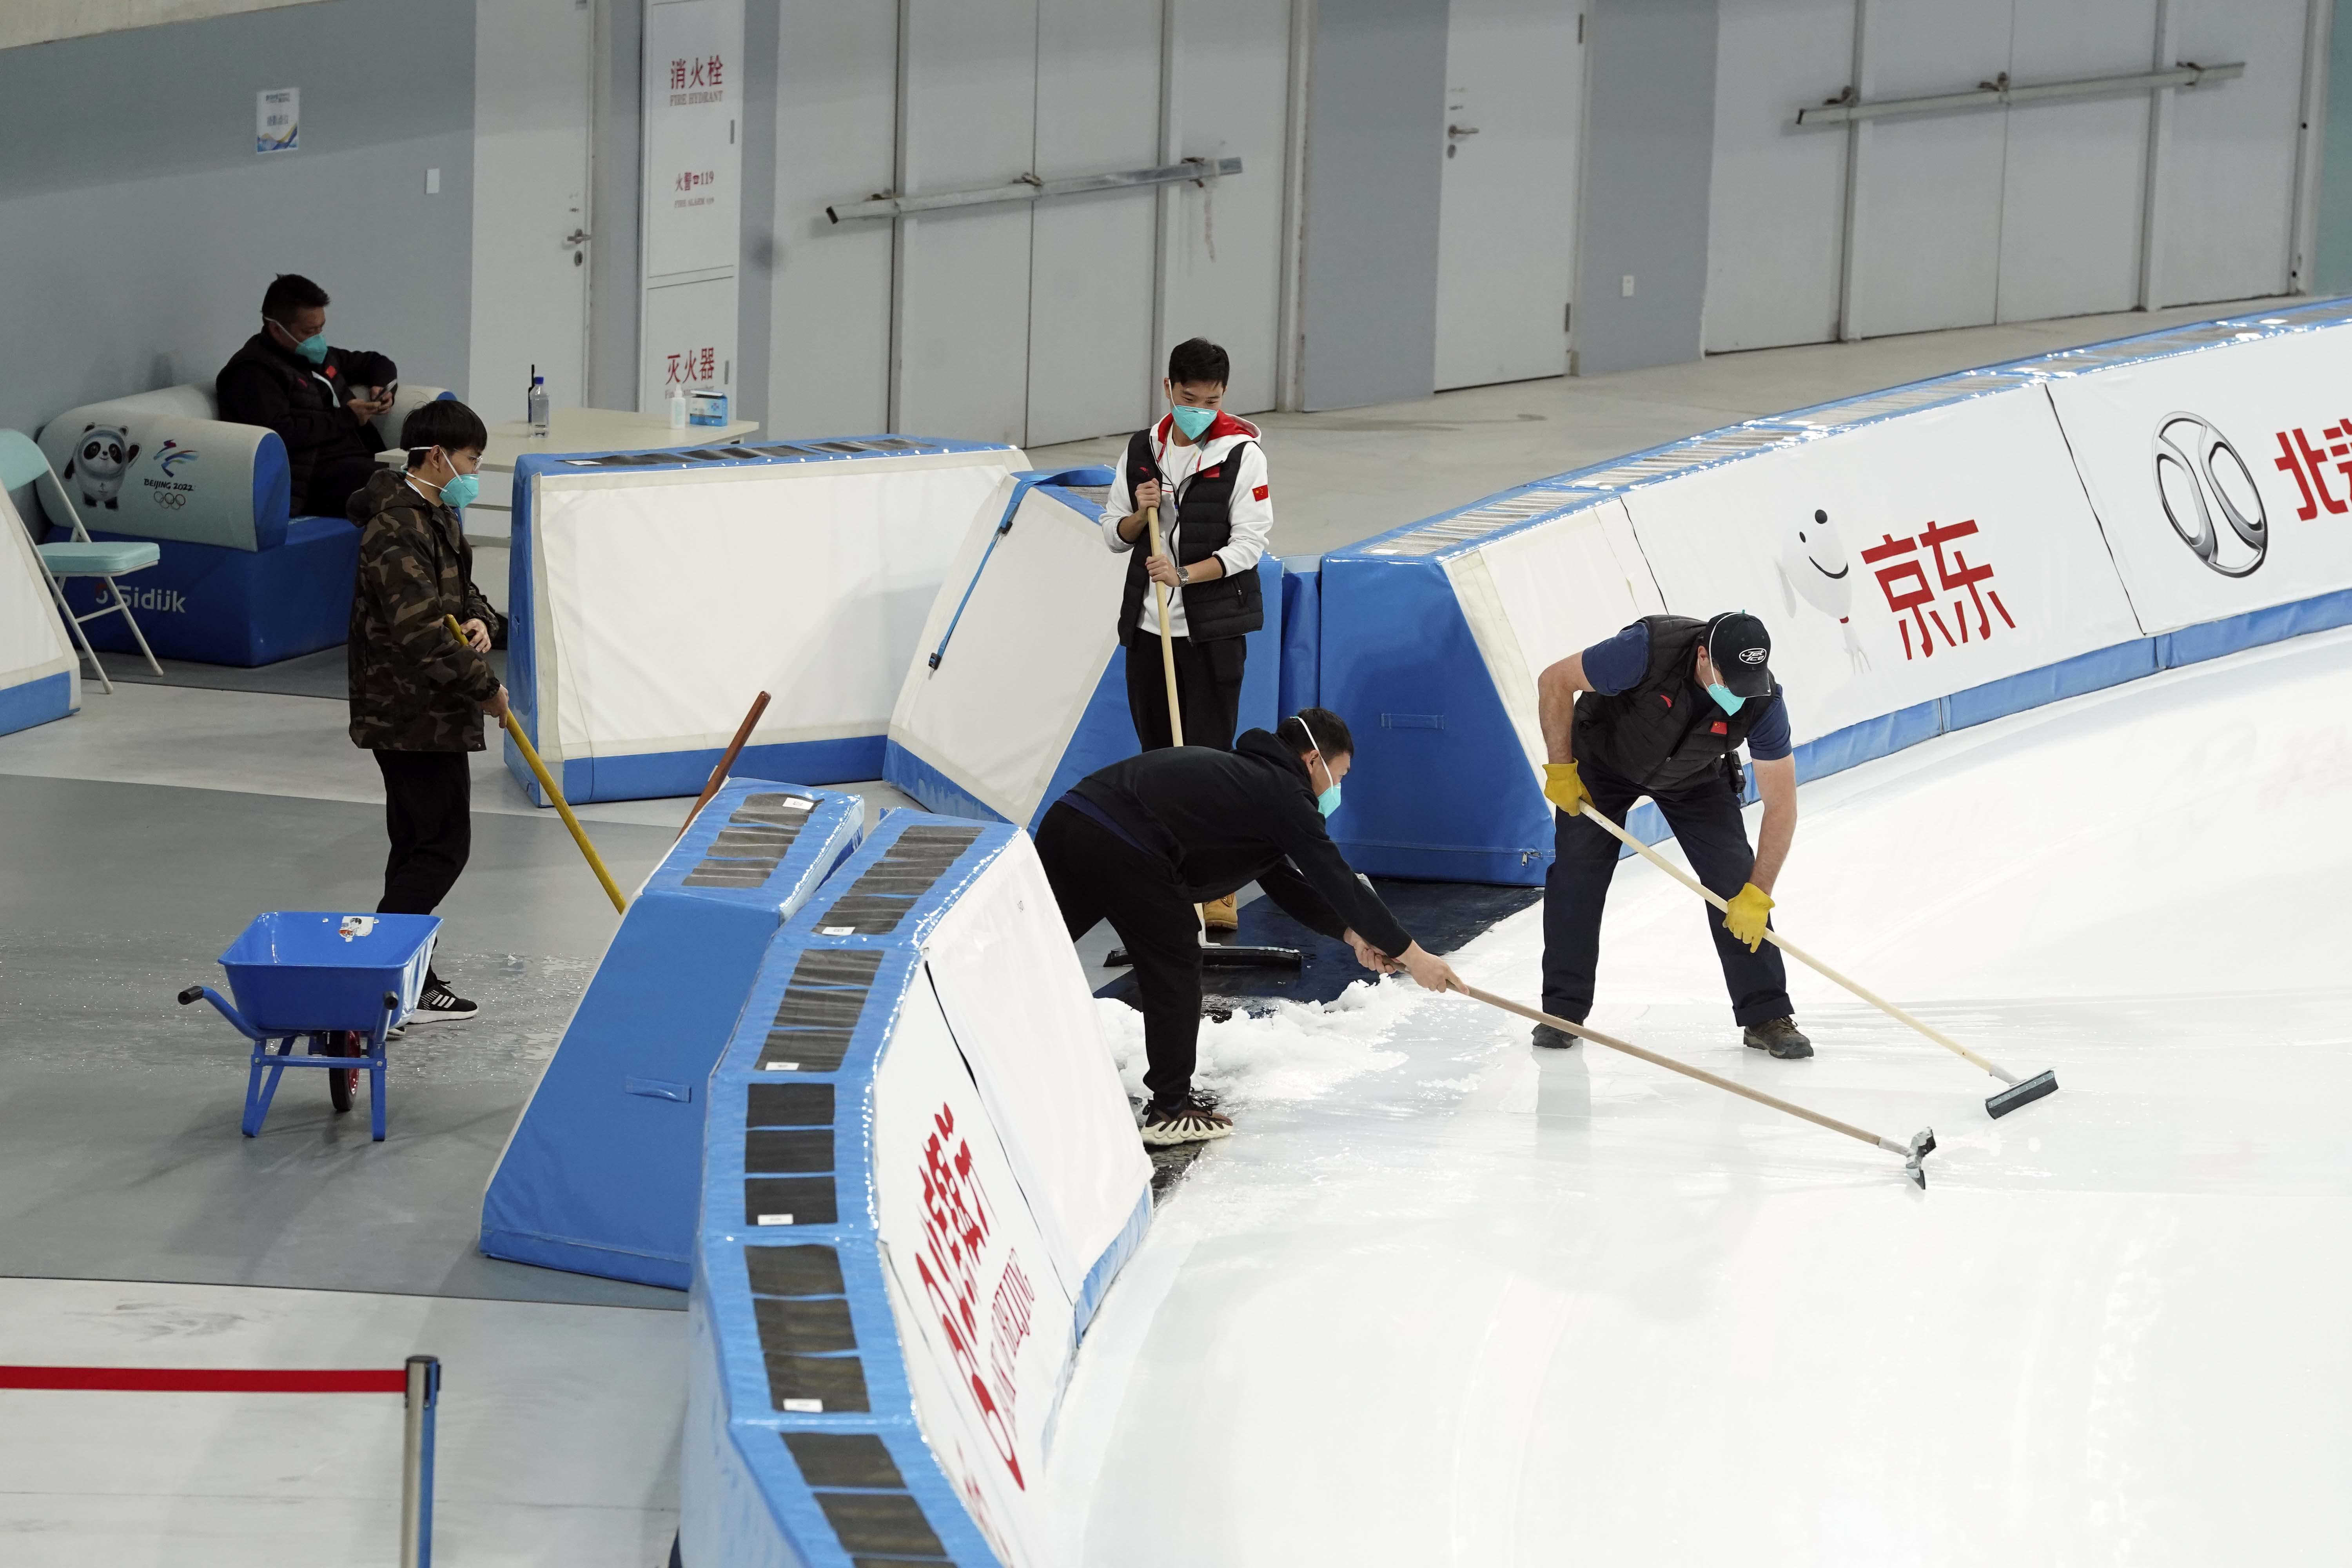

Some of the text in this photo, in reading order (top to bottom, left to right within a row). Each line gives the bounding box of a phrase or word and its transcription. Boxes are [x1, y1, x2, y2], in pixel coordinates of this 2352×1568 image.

[671, 55, 723, 89] 消火栓
[670, 90, 723, 106] FIRE HYDRANT
[665, 347, 715, 385] 灭火器
[144, 479, 194, 491] BEIJING 2022
[115, 585, 186, 613] Sidijk
[1861, 520, 2015, 660] 京东
